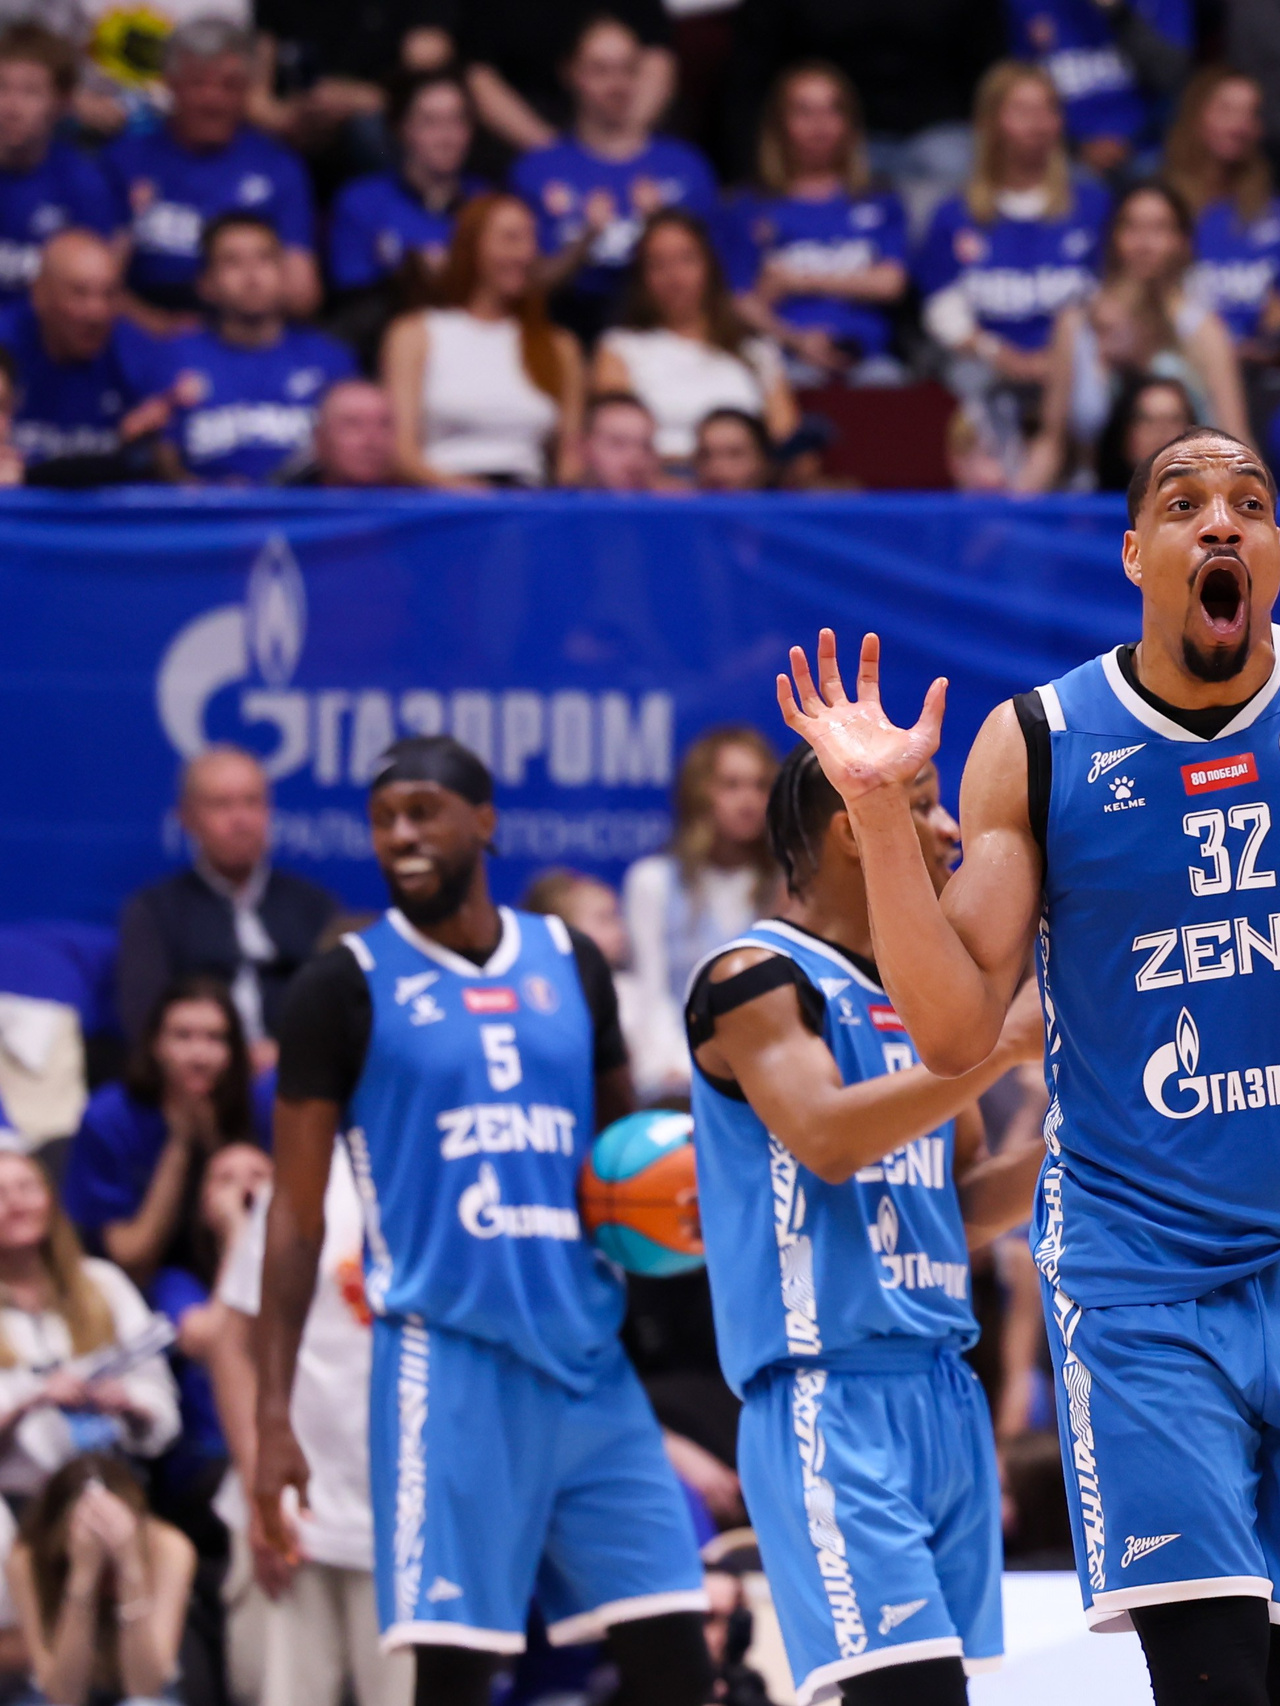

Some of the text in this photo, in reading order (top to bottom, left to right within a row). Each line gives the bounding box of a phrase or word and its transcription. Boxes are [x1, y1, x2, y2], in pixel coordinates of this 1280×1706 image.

[1190, 763, 1248, 786] 80 ПОБЕДА!
[1103, 797, 1146, 813] KELME
[1183, 801, 1276, 897] 32
[479, 1022, 523, 1091] 5
[436, 1102, 577, 1161] ZENIT
